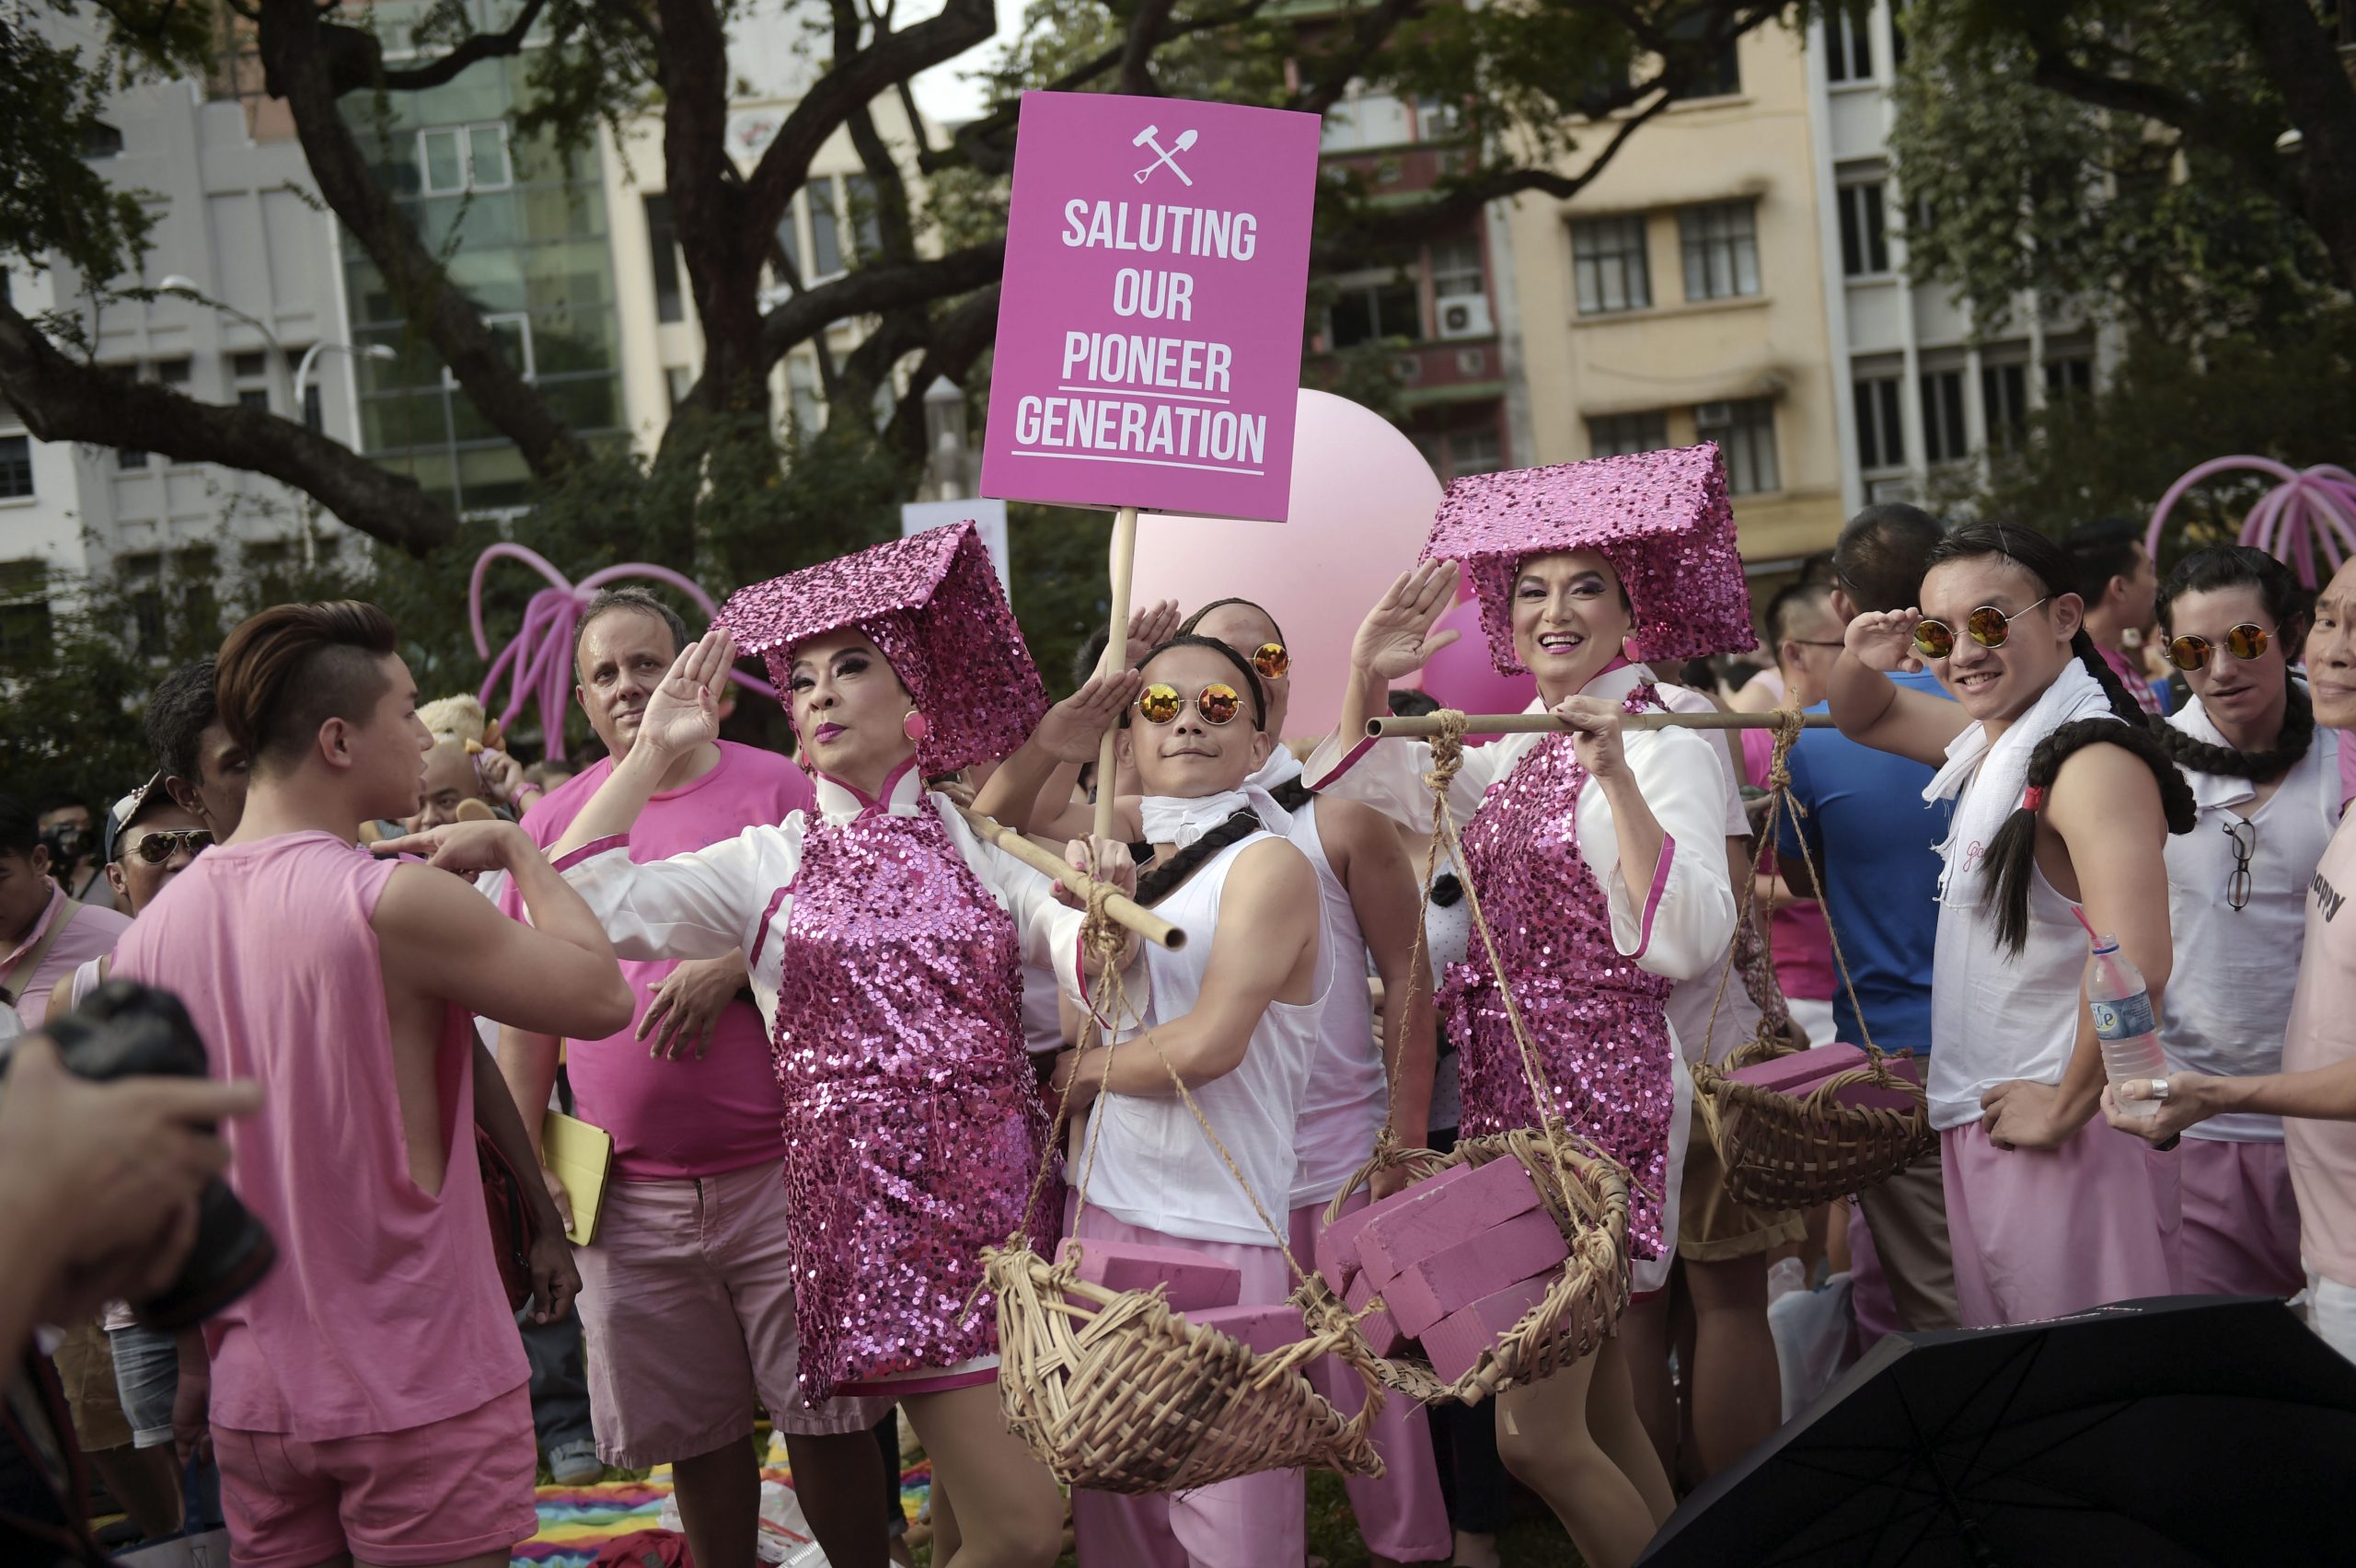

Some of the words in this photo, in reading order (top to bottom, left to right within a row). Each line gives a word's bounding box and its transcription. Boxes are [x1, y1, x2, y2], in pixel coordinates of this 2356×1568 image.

[1061, 198, 1257, 261] SALUTING
[1113, 268, 1194, 322] OUR
[1061, 330, 1232, 393] PIONEER
[1015, 395, 1267, 465] GENERATION
